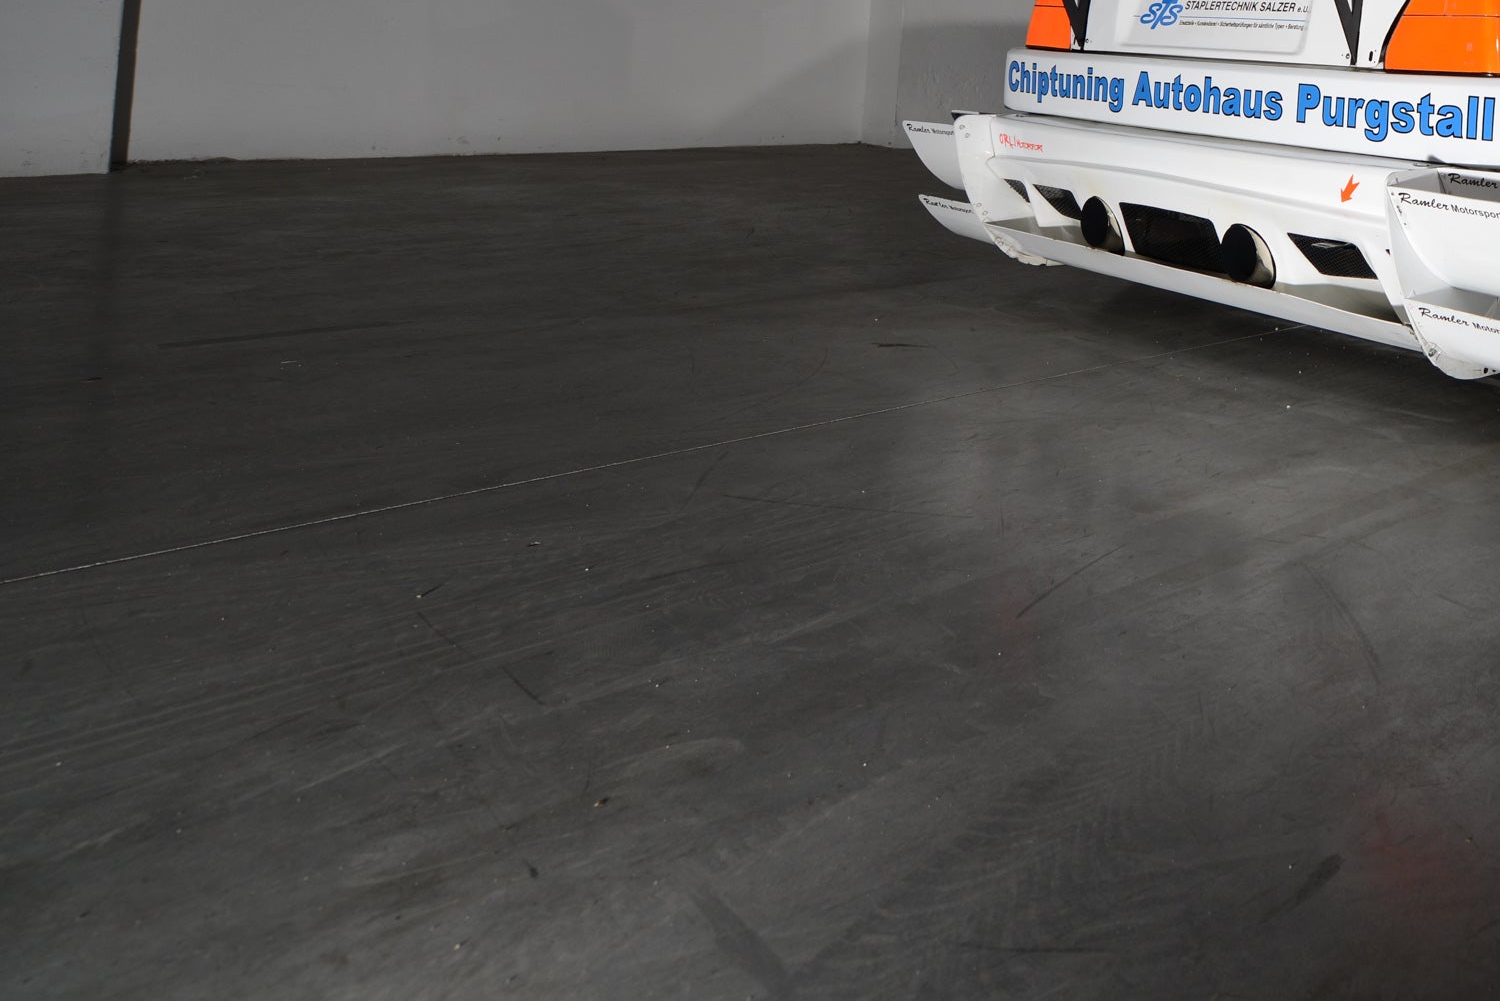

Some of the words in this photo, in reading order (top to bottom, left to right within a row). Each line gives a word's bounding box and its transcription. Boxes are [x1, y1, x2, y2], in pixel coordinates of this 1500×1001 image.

[1185, 0, 1258, 12] STAPLERTECHNIK
[1259, 1, 1296, 13] SALZER
[1008, 60, 1125, 113] Chiptuning
[1132, 70, 1283, 121] Autohaus
[1296, 82, 1496, 143] Purgstall
[1448, 172, 1498, 189] Ramler
[1398, 192, 1450, 211] Ramler
[1418, 307, 1469, 327] Ramler
